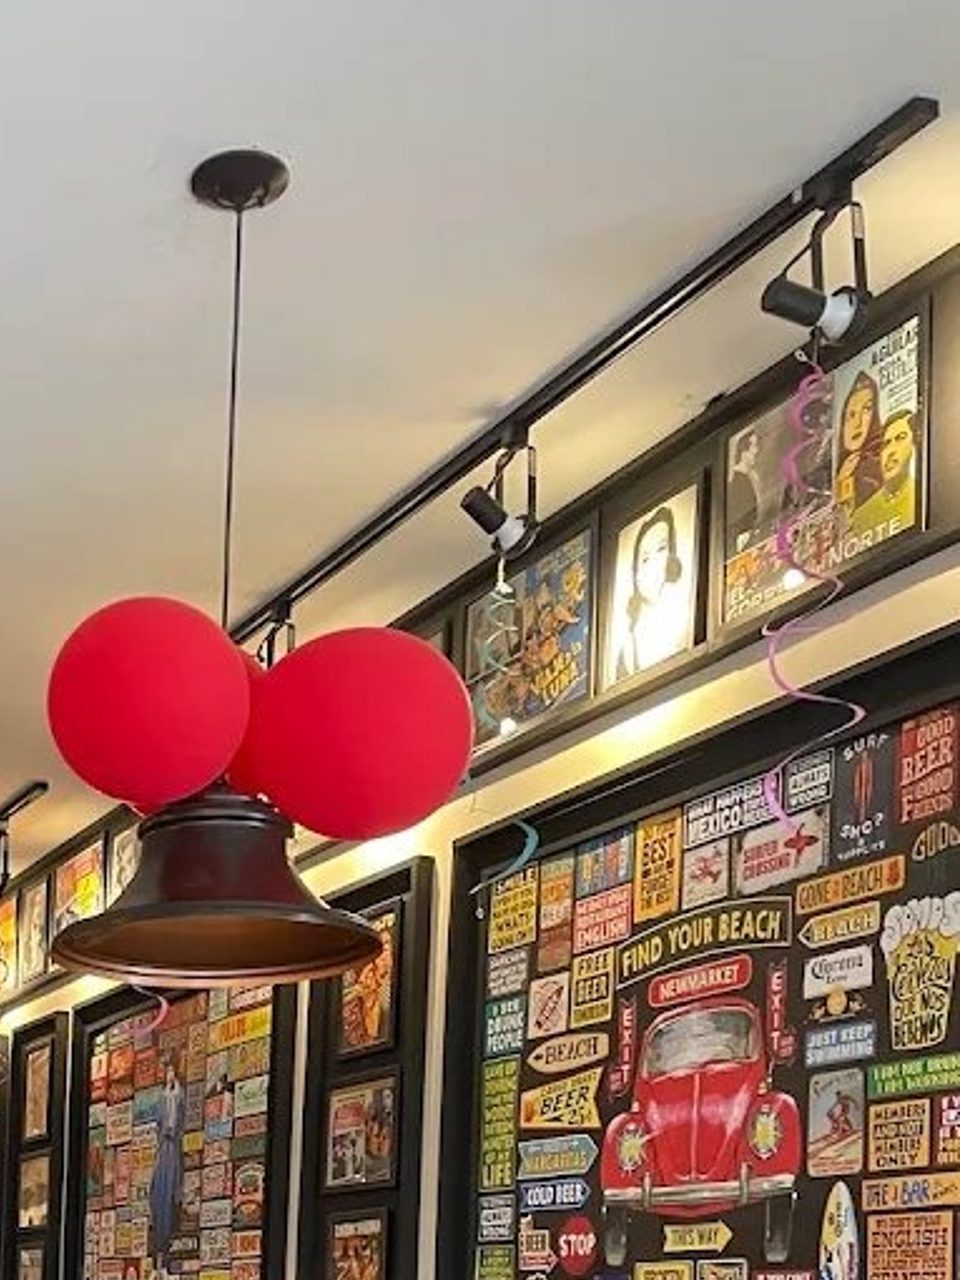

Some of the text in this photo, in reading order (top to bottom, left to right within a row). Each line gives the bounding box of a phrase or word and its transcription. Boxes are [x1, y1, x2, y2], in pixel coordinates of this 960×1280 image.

[828, 514, 901, 567] NORTE
[917, 716, 954, 748] GOOD
[842, 733, 890, 763] SURF
[901, 737, 954, 786] BEER
[688, 804, 741, 844] MEXICO
[643, 832, 675, 868] BEST
[841, 863, 884, 899] BEACH
[813, 911, 875, 943] BEACH
[622, 910, 782, 978] FIND YOUR BEACH
[578, 952, 609, 976] FREE
[811, 955, 863, 980] Corona
[576, 975, 608, 1002] BEER
[659, 965, 740, 1001] NEWMARKET
[770, 971, 784, 1050] EXIT
[545, 1036, 599, 1066] BEACH
[621, 1008, 633, 1084] EXIT
[808, 1031, 838, 1048] JUST
[841, 1024, 873, 1043] KEEP
[541, 1086, 589, 1116] BEER
[874, 1103, 926, 1120] MEMBERS
[874, 1138, 921, 1155] MEMBERS
[876, 1152, 919, 1169] ONLY
[482, 1162, 512, 1187] LIFE
[527, 1186, 554, 1206] COLD
[555, 1183, 583, 1204] BEER
[901, 1179, 931, 1205] BAR
[558, 1232, 597, 1258] STOP
[671, 1227, 720, 1246] THIS WAY
[871, 1227, 948, 1249] ENGLISH
